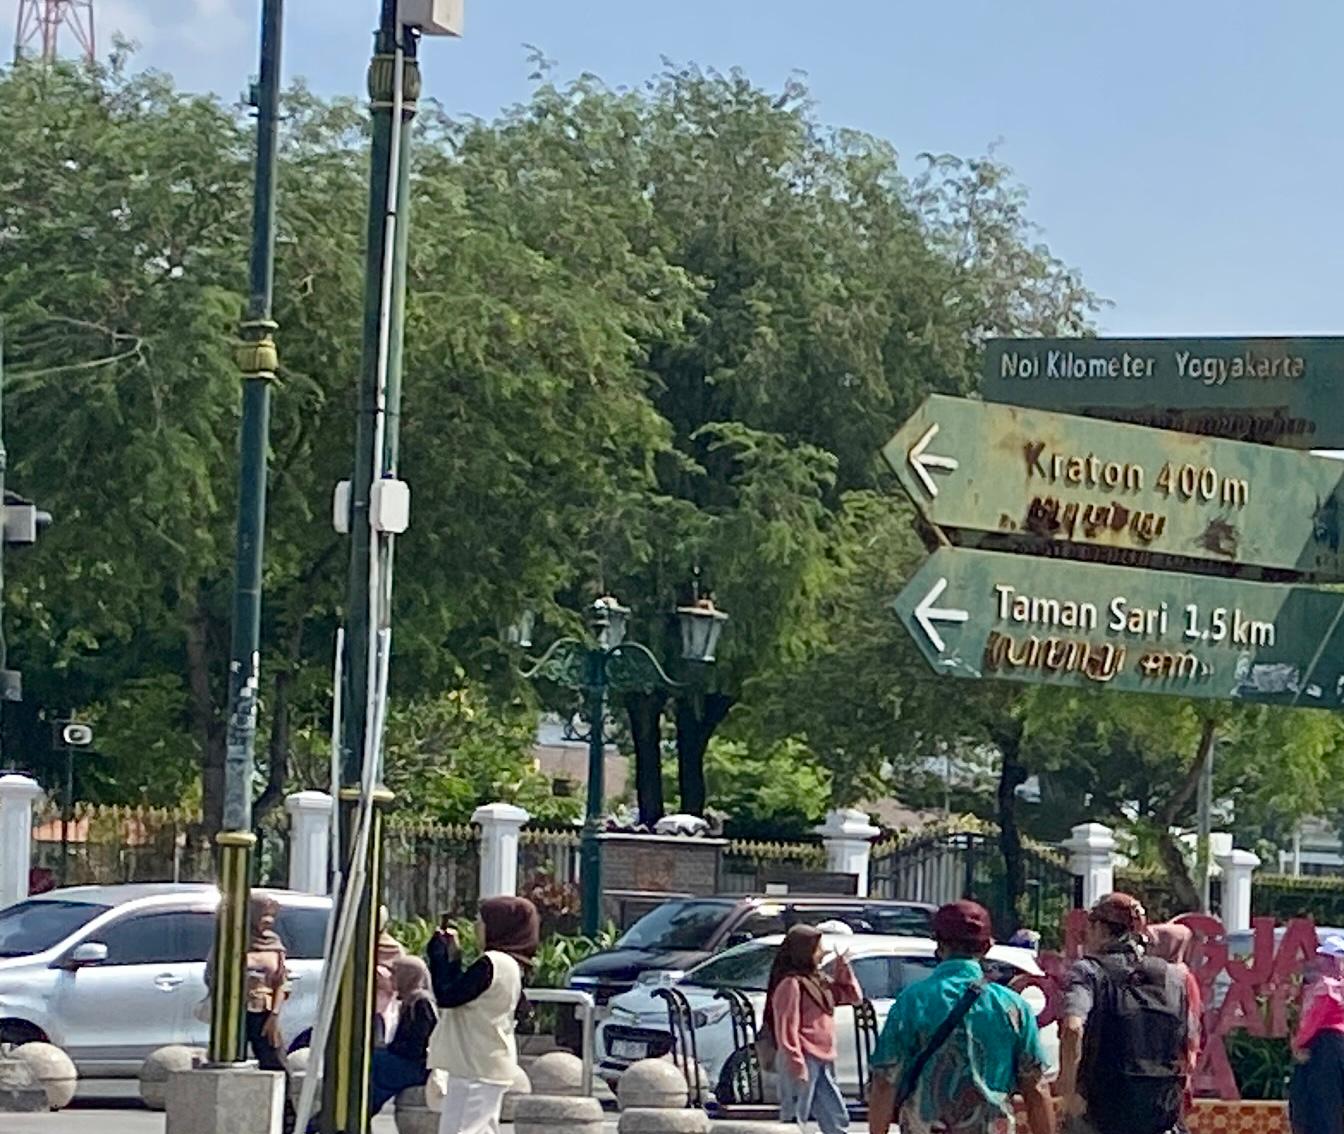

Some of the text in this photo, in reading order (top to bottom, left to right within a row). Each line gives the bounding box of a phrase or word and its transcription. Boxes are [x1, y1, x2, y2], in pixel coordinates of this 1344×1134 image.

[1046, 349, 1156, 379] Kilometer
[1175, 350, 1306, 385] Yogyakarta
[1023, 440, 1145, 489] Kraton
[994, 583, 1098, 629] Taman
[1109, 596, 1169, 635] Sari
